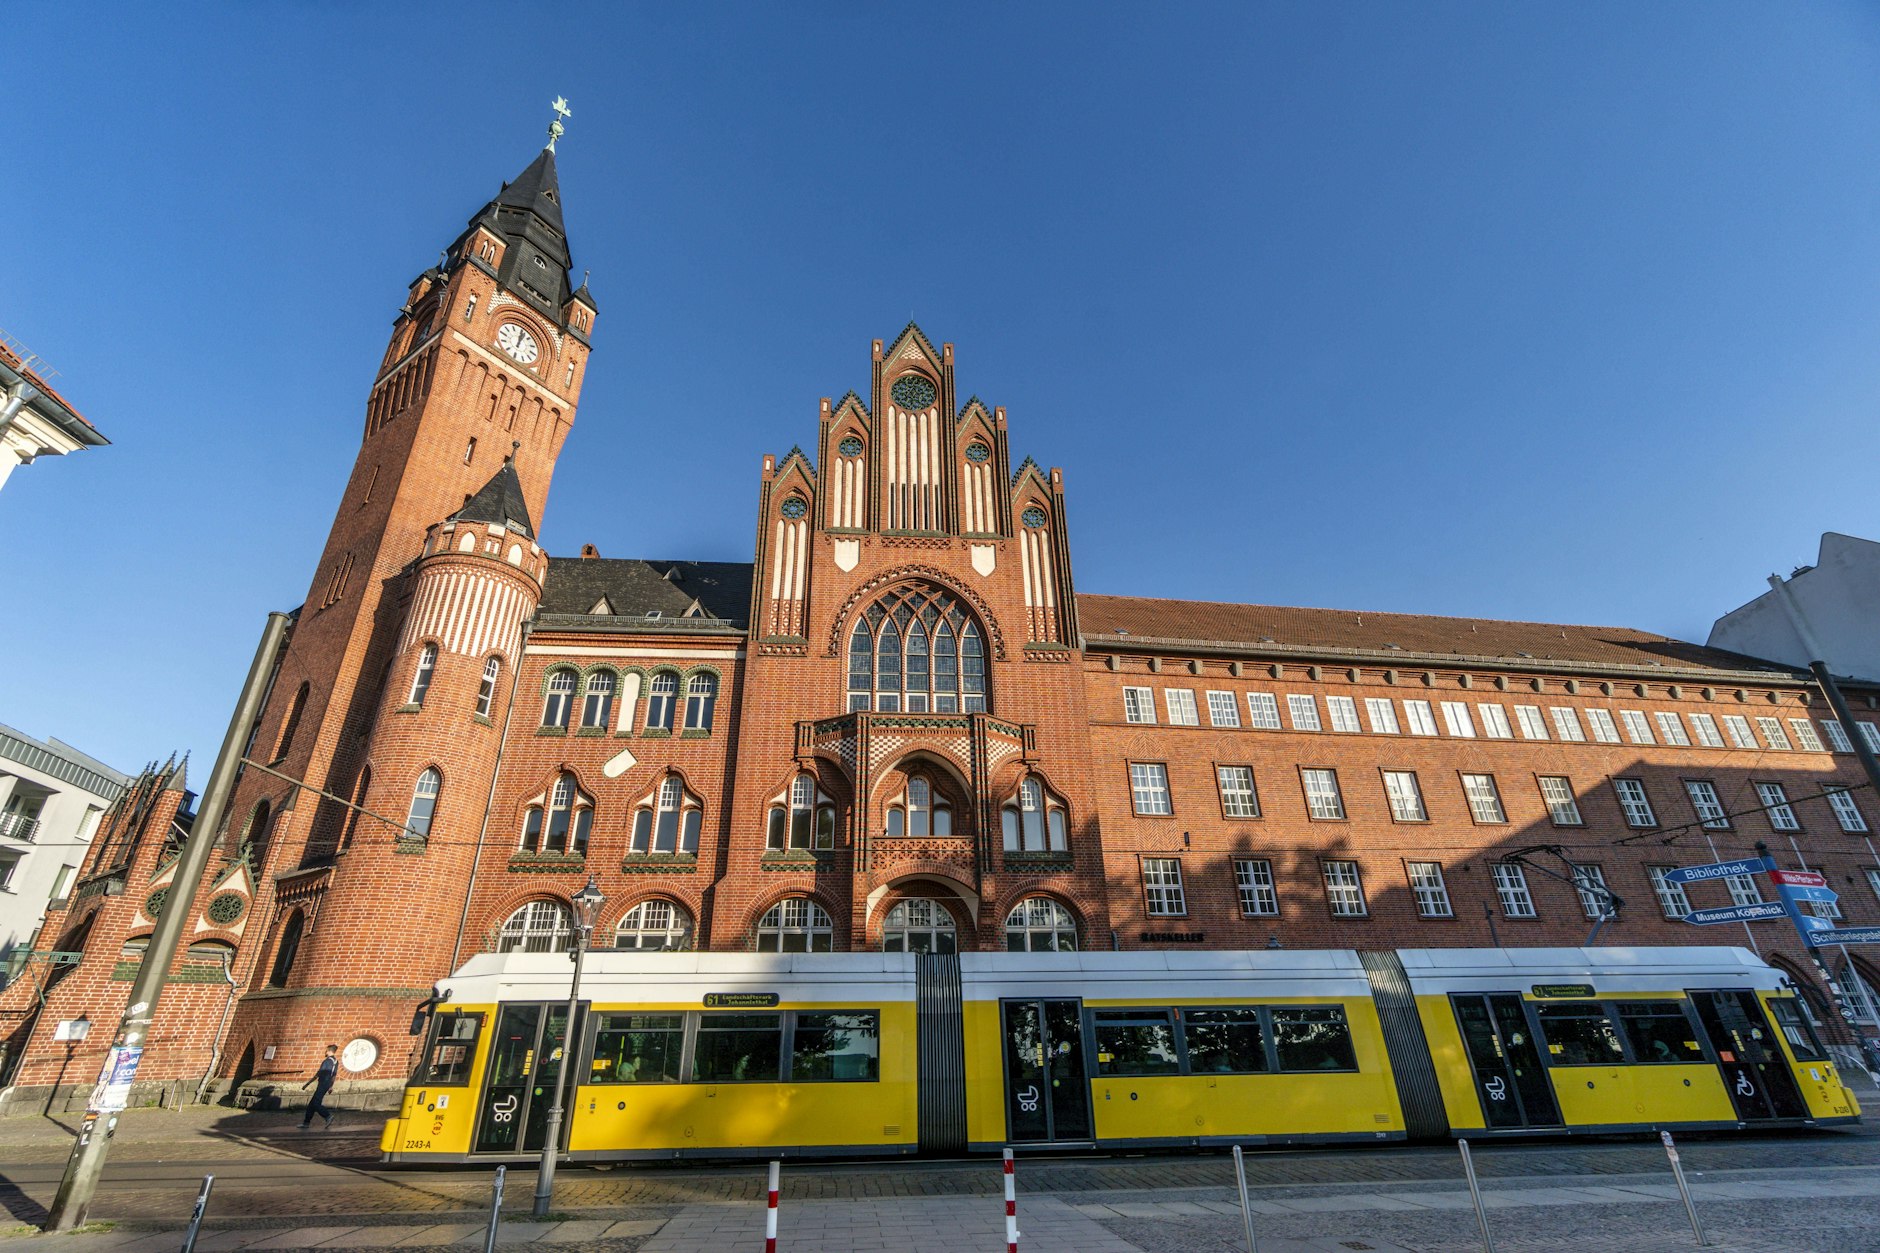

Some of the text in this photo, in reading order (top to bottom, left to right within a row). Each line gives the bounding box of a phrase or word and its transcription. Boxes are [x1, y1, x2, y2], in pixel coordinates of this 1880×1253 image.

[1684, 863, 1749, 880] Bibliothek
[1695, 910, 1736, 922] Museum
[1141, 932, 1204, 942] RATSKELLER
[707, 994, 719, 1006] 61
[405, 1140, 431, 1149] 2243-A
